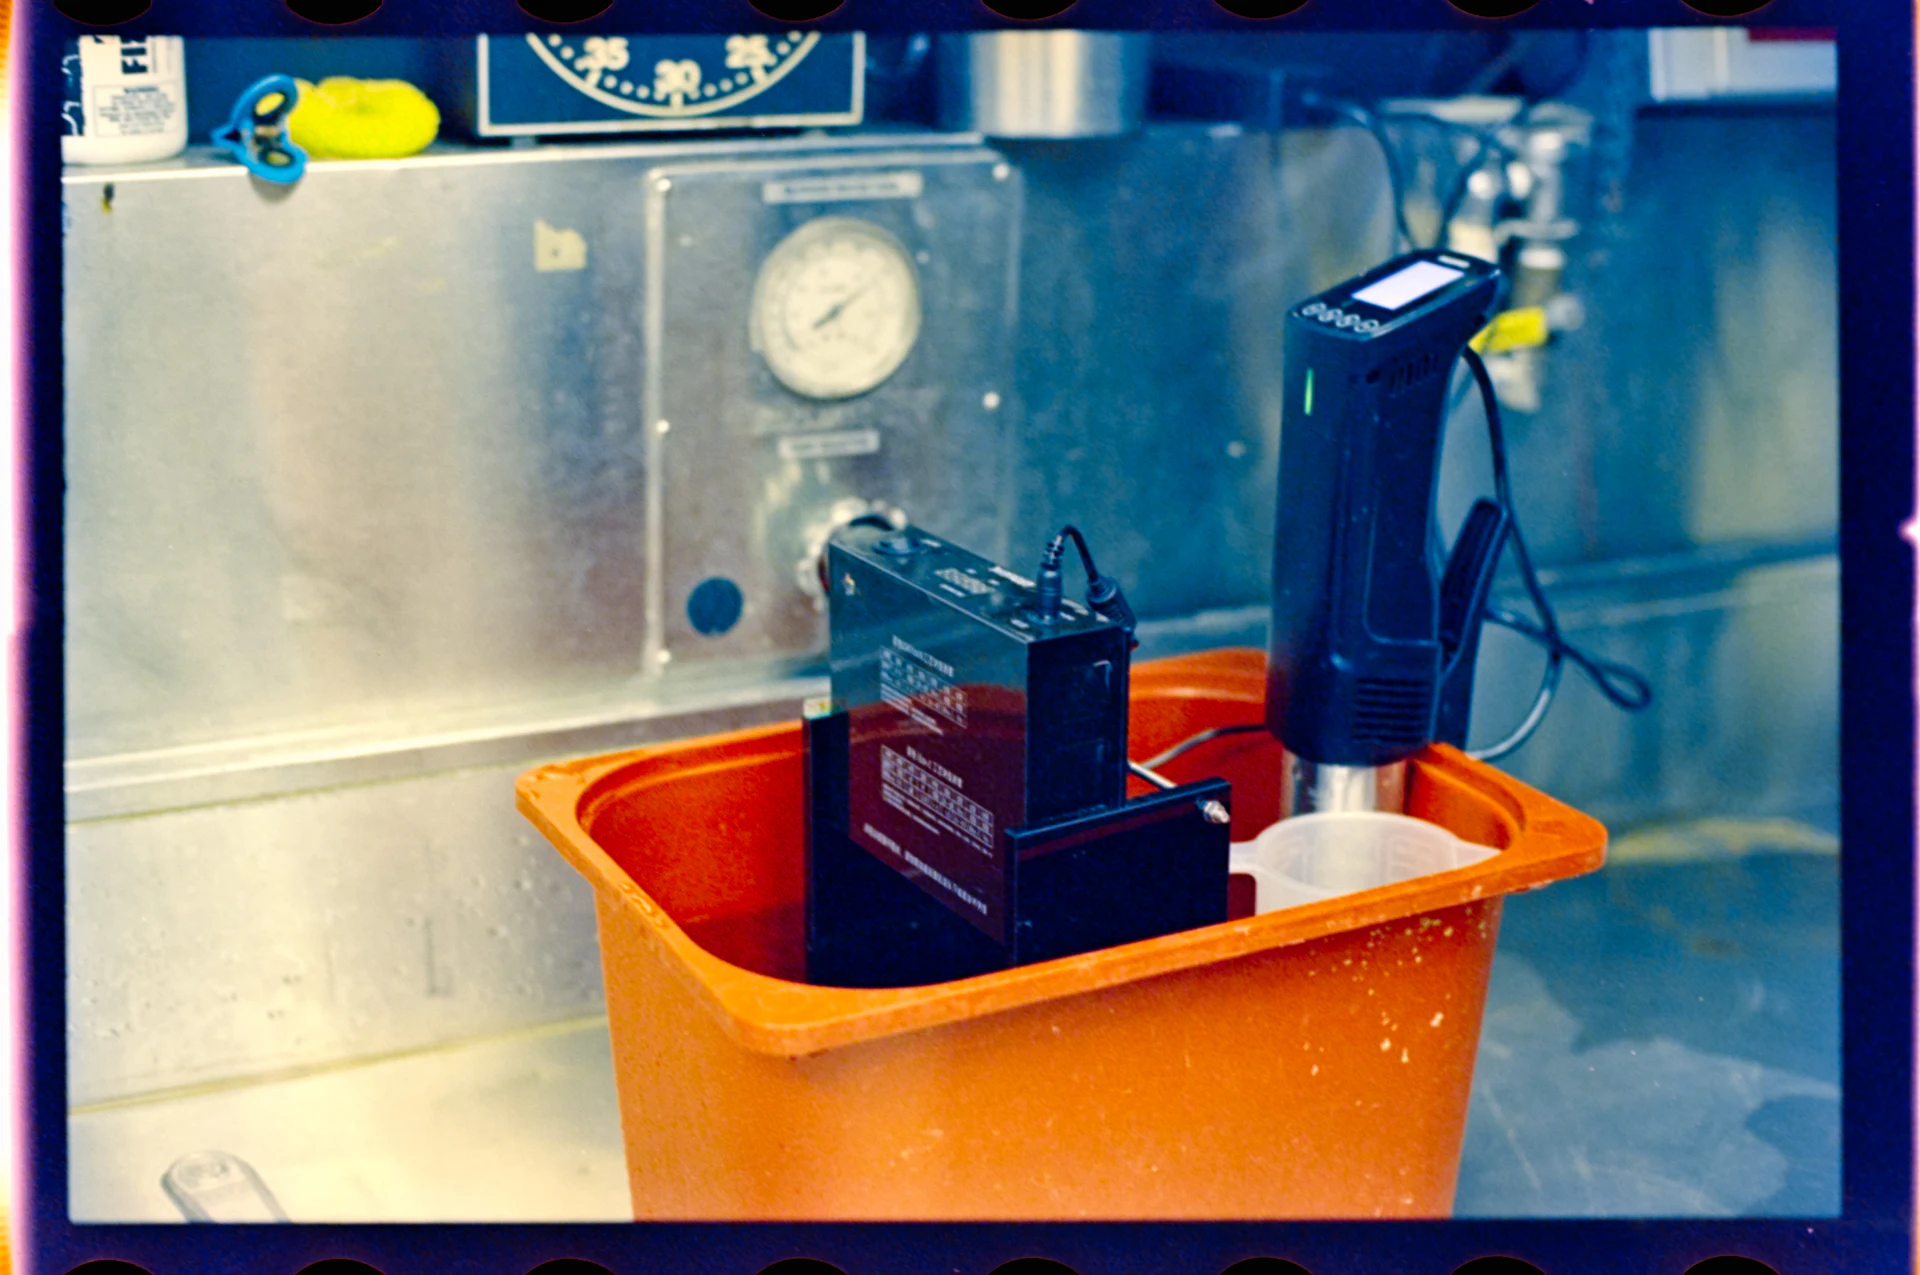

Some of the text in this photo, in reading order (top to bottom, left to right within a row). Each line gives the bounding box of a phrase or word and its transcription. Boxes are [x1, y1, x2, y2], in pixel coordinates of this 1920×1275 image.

[583, 35, 630, 71] 35
[725, 34, 769, 69] 25
[653, 58, 701, 91] 30
